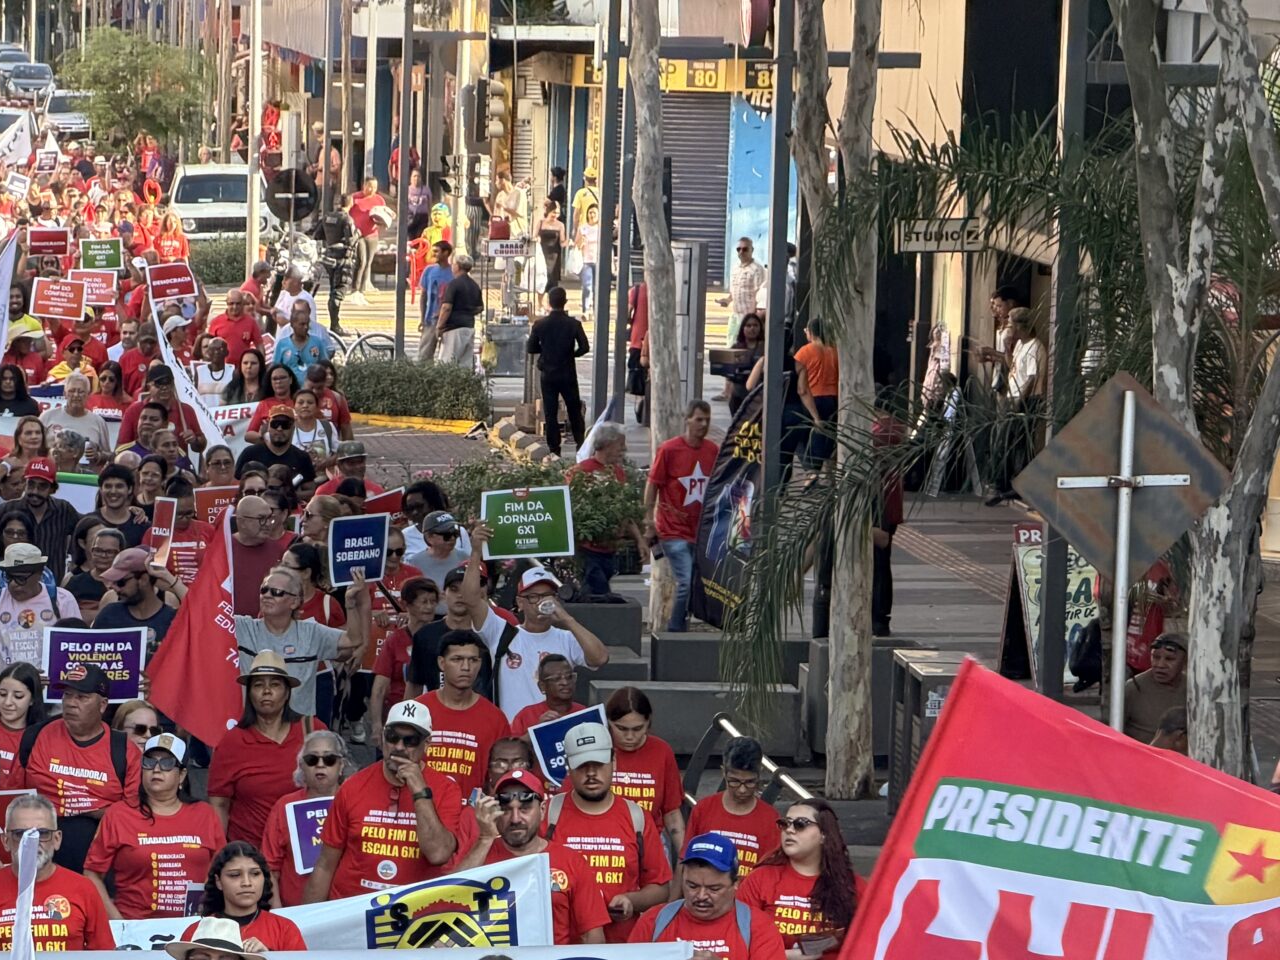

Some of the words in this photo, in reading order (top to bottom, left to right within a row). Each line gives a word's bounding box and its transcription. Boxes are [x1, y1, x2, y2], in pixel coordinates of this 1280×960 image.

[152, 276, 192, 287] DEMOCRACIA
[31, 462, 50, 473] LULA
[688, 477, 707, 493] PT
[504, 501, 526, 514] FIM
[528, 501, 545, 512] DA
[497, 511, 553, 526] JORNADA
[517, 523, 536, 536] 6X1
[345, 536, 375, 550] BRASIL
[60, 642, 93, 653] PELO
[94, 642, 115, 652] FIM
[116, 640, 133, 651] DA
[68, 650, 123, 662] VIOLÊNCIA
[361, 825, 385, 840] PELO
[387, 828, 408, 841] FIM
[922, 782, 1204, 876] PRESIDENTE
[361, 843, 399, 857] ESCALA
[590, 855, 609, 868] FIM
[611, 856, 626, 869] DA
[37, 924, 55, 938] FIM
[54, 924, 69, 938] DA
